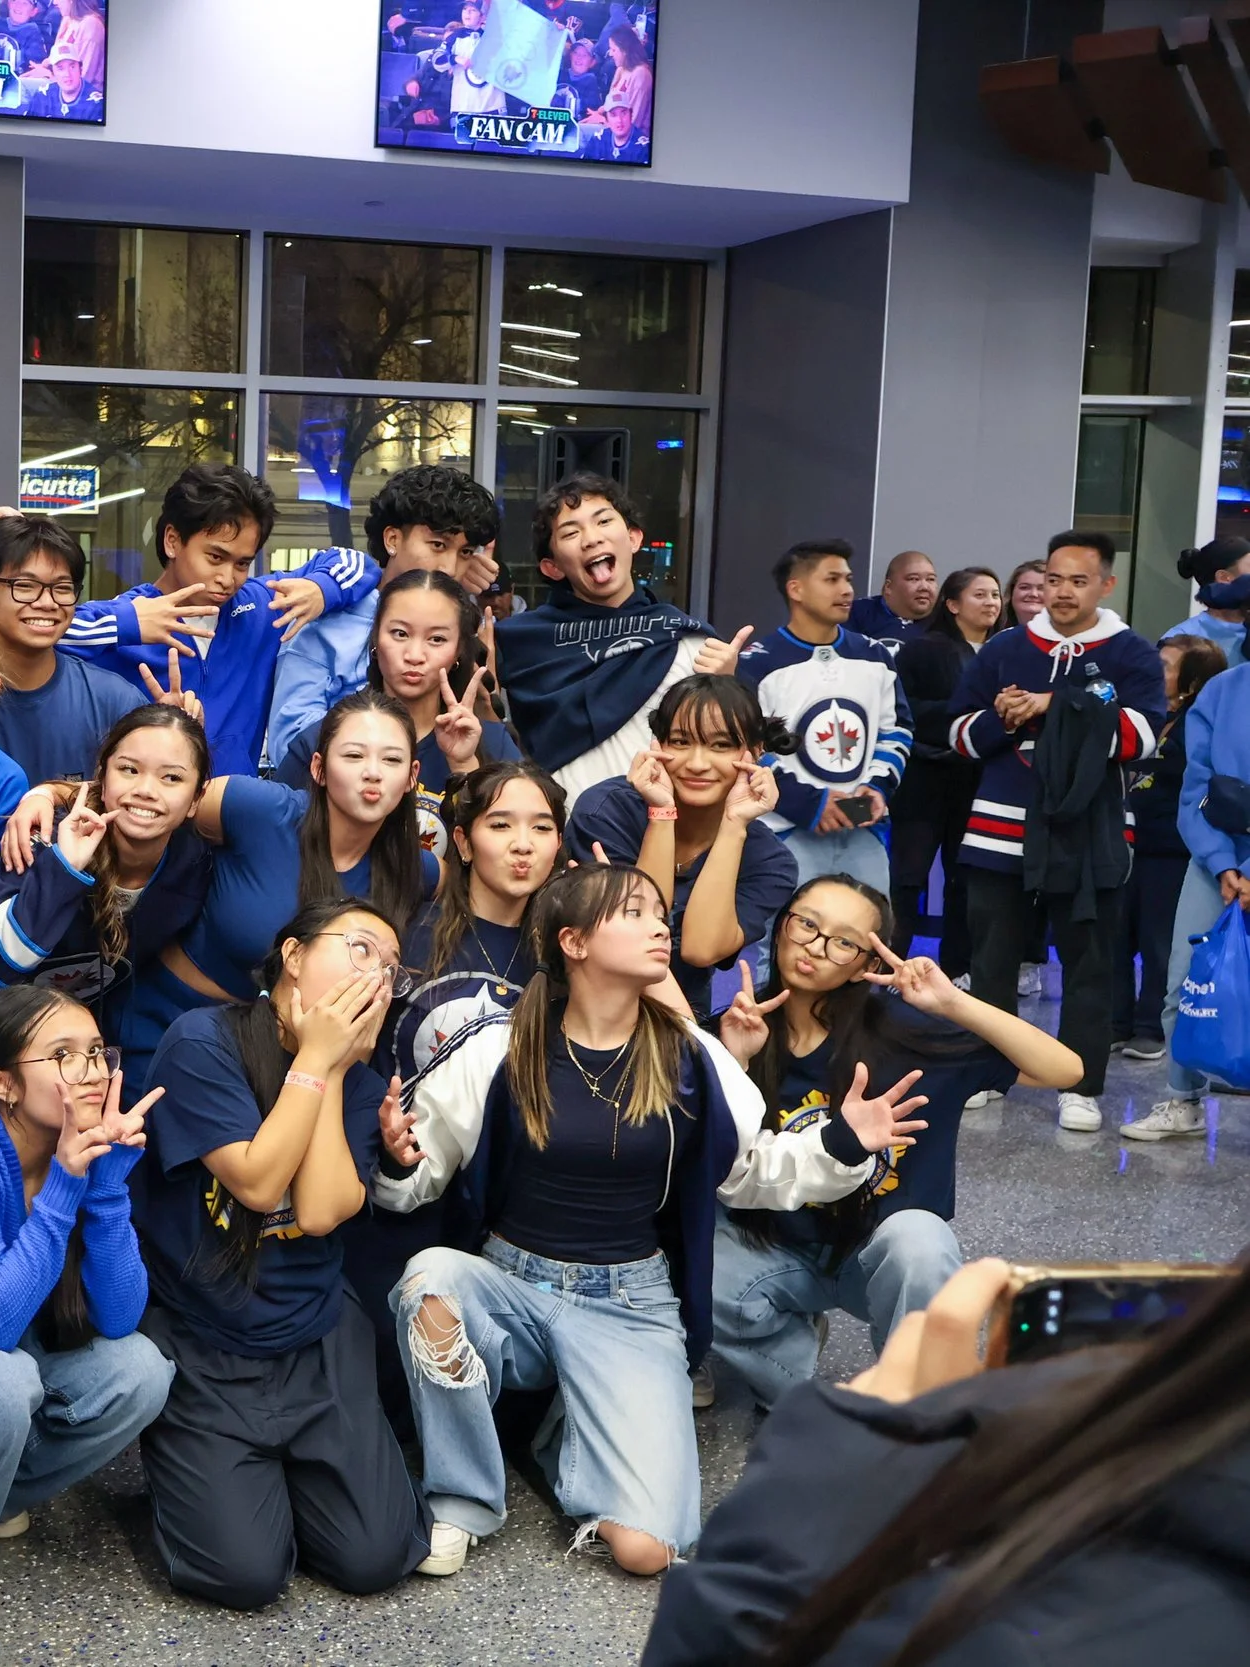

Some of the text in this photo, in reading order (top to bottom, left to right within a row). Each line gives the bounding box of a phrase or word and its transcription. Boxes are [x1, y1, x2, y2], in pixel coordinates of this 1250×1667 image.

[469, 117, 567, 145] FAN CAM
[231, 602, 256, 617] adidas
